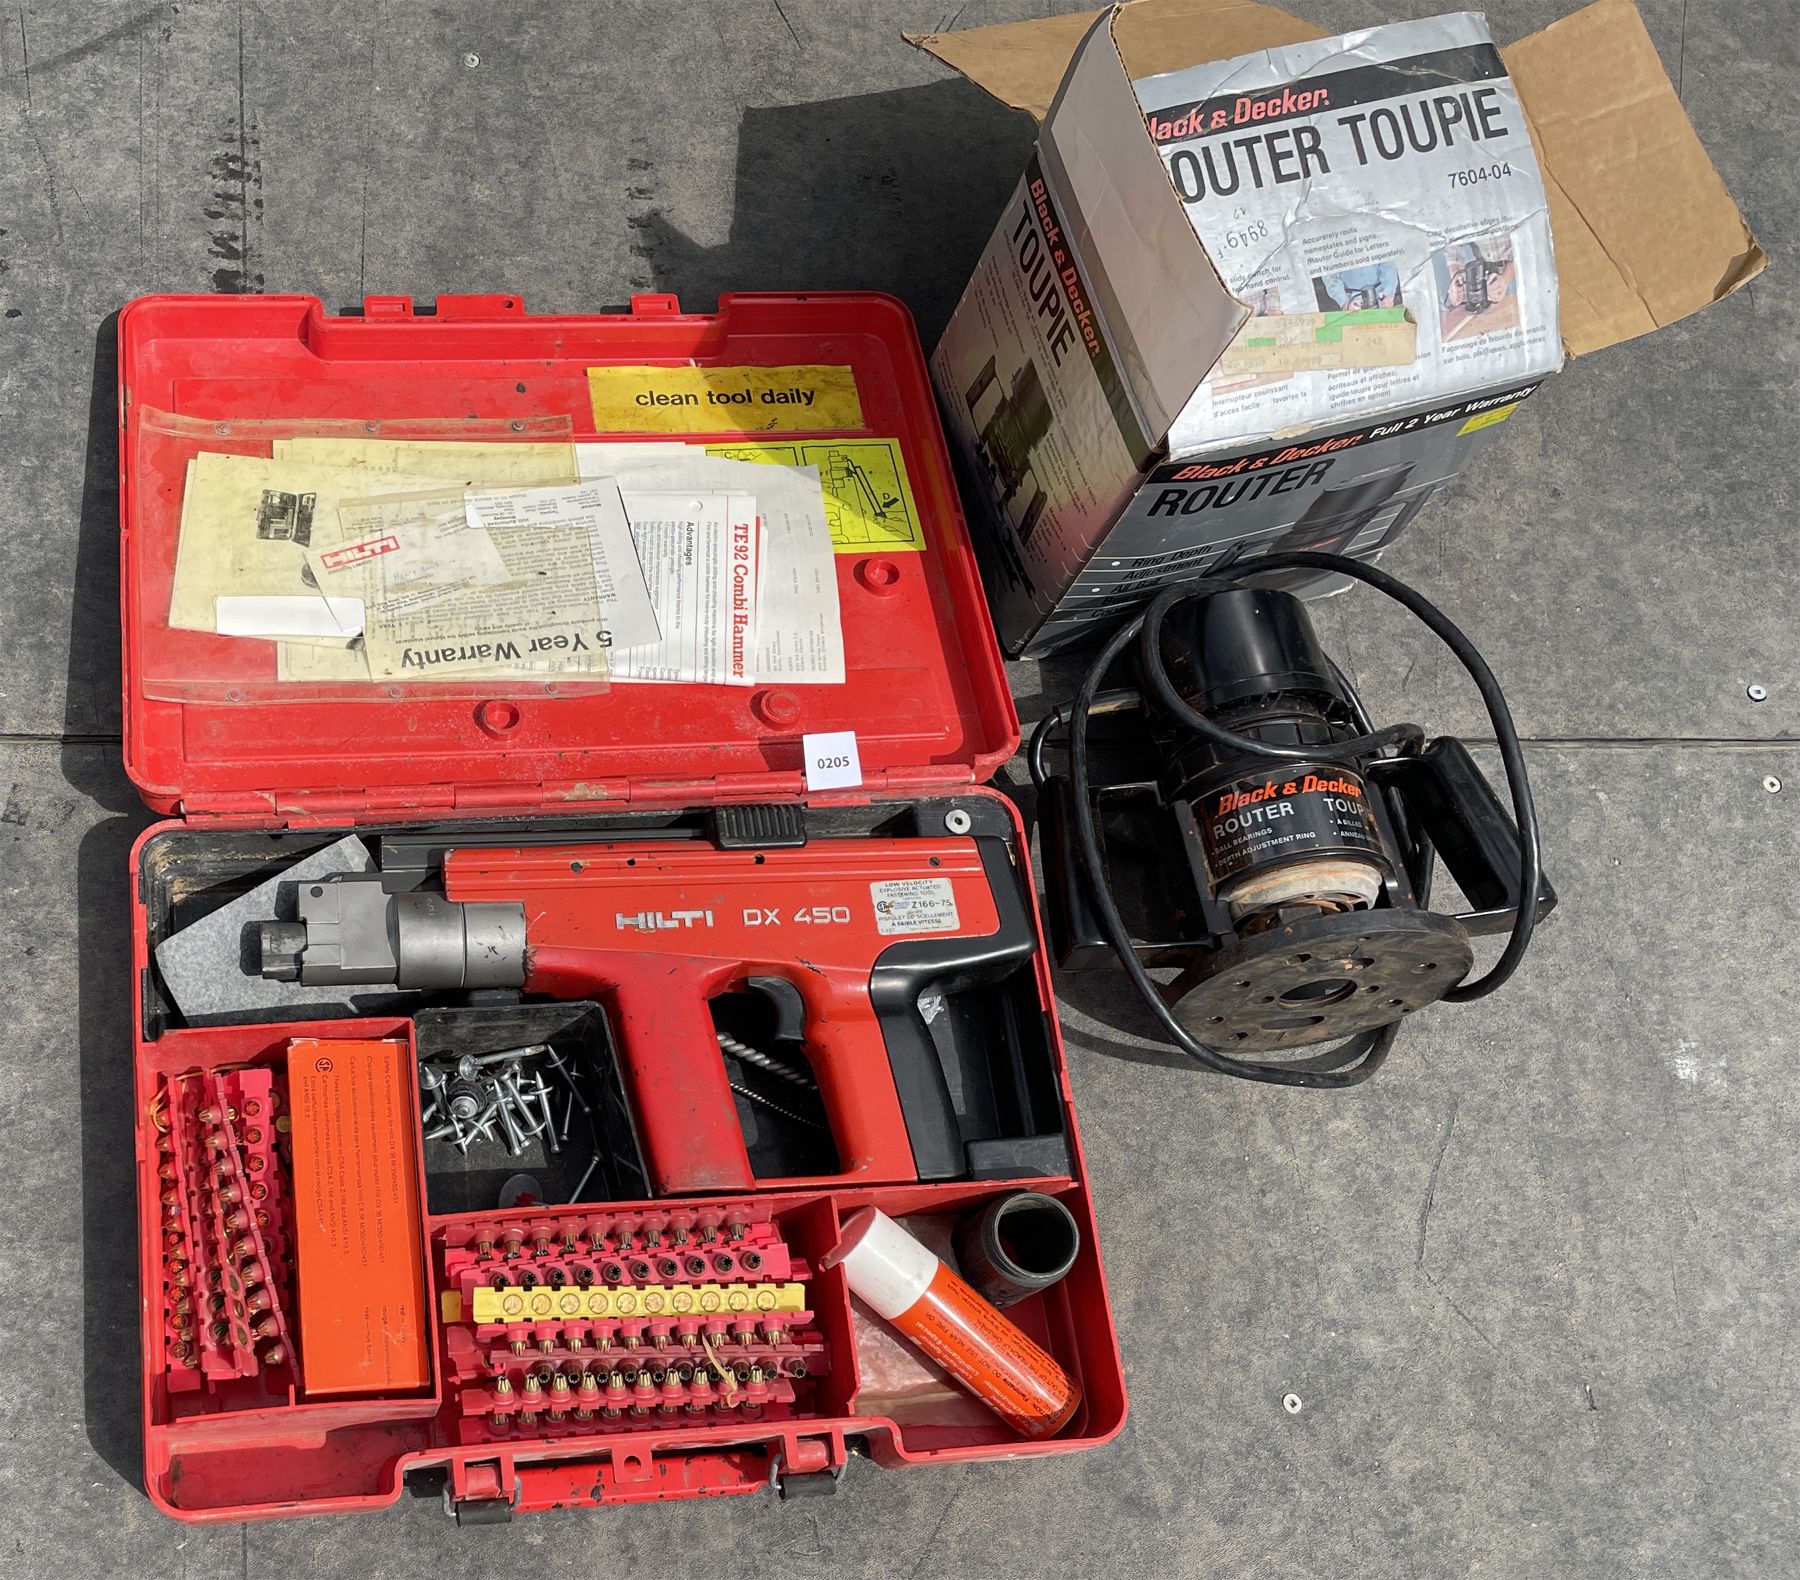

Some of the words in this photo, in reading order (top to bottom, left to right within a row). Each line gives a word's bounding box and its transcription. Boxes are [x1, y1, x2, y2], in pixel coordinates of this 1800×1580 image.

[1150, 109, 1204, 142] lack
[1210, 109, 1228, 130] &
[1170, 126, 1330, 204] OUTER
[1338, 88, 1508, 165] TOUPIE
[1448, 163, 1512, 188] 7604-04
[1030, 177, 1058, 245] Black
[1054, 248, 1066, 266] &
[1302, 230, 1339, 245] Accurately
[1303, 239, 1343, 255] nameplates
[1344, 236, 1358, 247] and
[1332, 247, 1353, 259] Guide
[1354, 245, 1364, 255] for
[1365, 240, 1389, 253] Letters
[1308, 264, 1322, 275] and
[1322, 258, 1354, 272] Numbers
[1354, 255, 1370, 266] sold
[1011, 200, 1076, 367] TOUPIE
[1245, 280, 1262, 289] hand
[1326, 369, 1350, 380] Permet
[1373, 381, 1388, 390] pour
[1389, 375, 1411, 385] lettres
[636, 390, 698, 406] clean
[707, 390, 752, 405] tool
[760, 388, 816, 406] daily
[1211, 392, 1252, 407] Interrupteur
[1253, 384, 1288, 397] coulissant
[1329, 397, 1356, 408] chiffres
[1172, 460, 1247, 481] Black
[1249, 456, 1267, 470] &
[1370, 420, 1403, 439] Full
[1404, 417, 1420, 430] 2
[1422, 407, 1462, 426] Year
[1464, 385, 1537, 413] Warranty
[1147, 458, 1336, 516] ROUTER
[323, 537, 399, 567] HILTI
[686, 522, 694, 566] Advantages
[1132, 556, 1166, 568] Ring
[1170, 545, 1212, 561] Depth
[1122, 558, 1205, 580] Adjustment
[732, 562, 748, 612] Combi
[1110, 584, 1129, 594] All
[1134, 577, 1162, 589] Ball
[582, 592, 615, 601] WARRANTY
[529, 633, 590, 652] Year
[596, 630, 612, 648] 5
[732, 613, 748, 679] Hammer
[400, 642, 521, 668] Warranty
[818, 756, 850, 770] 0205
[1215, 780, 1280, 818] Black
[1282, 781, 1298, 795] &
[1213, 802, 1295, 840] ROUTER
[1214, 842, 1232, 853] BALL
[1232, 827, 1273, 846] BEARINGS
[1342, 819, 1364, 828] BILLES
[1218, 851, 1242, 866] DEPTH
[1242, 834, 1296, 858] ADJUSTMENT
[1296, 831, 1317, 841] RING
[616, 910, 714, 930] HILTI
[743, 908, 781, 926] DX
[793, 906, 850, 924] 450
[916, 912, 954, 920] SCELLEMENT
[364, 1055, 373, 1080] Charges
[332, 1074, 340, 1092] These
[309, 1092, 318, 1121] cartuchos
[333, 1093, 342, 1122] cartridges
[382, 1055, 390, 1073] Safety
[388, 1140, 395, 1150] DX
[334, 1123, 343, 1147] conform
[322, 1109, 331, 1140] conformes
[328, 1211, 336, 1227] ANSI
[370, 1154, 379, 1167] pour
[356, 1202, 364, 1212] DX
[373, 1198, 382, 1208] DX
[340, 1219, 348, 1235] ANSI
[924, 1310, 935, 1321] OR
[935, 1320, 949, 1333] FIRE
[949, 1332, 966, 1347] NEAR
[1000, 1340, 1011, 1350] OF
[965, 1345, 978, 1358] USE
[1008, 1347, 1028, 1365] REACH
[978, 1356, 991, 1369] NOT
[1026, 1362, 1039, 1374] THE
[990, 1367, 1001, 1378] DO
[1037, 1372, 1048, 1382] OF
[1001, 1376, 1030, 1402] Flammable
[1046, 1379, 1058, 1391] OUT
